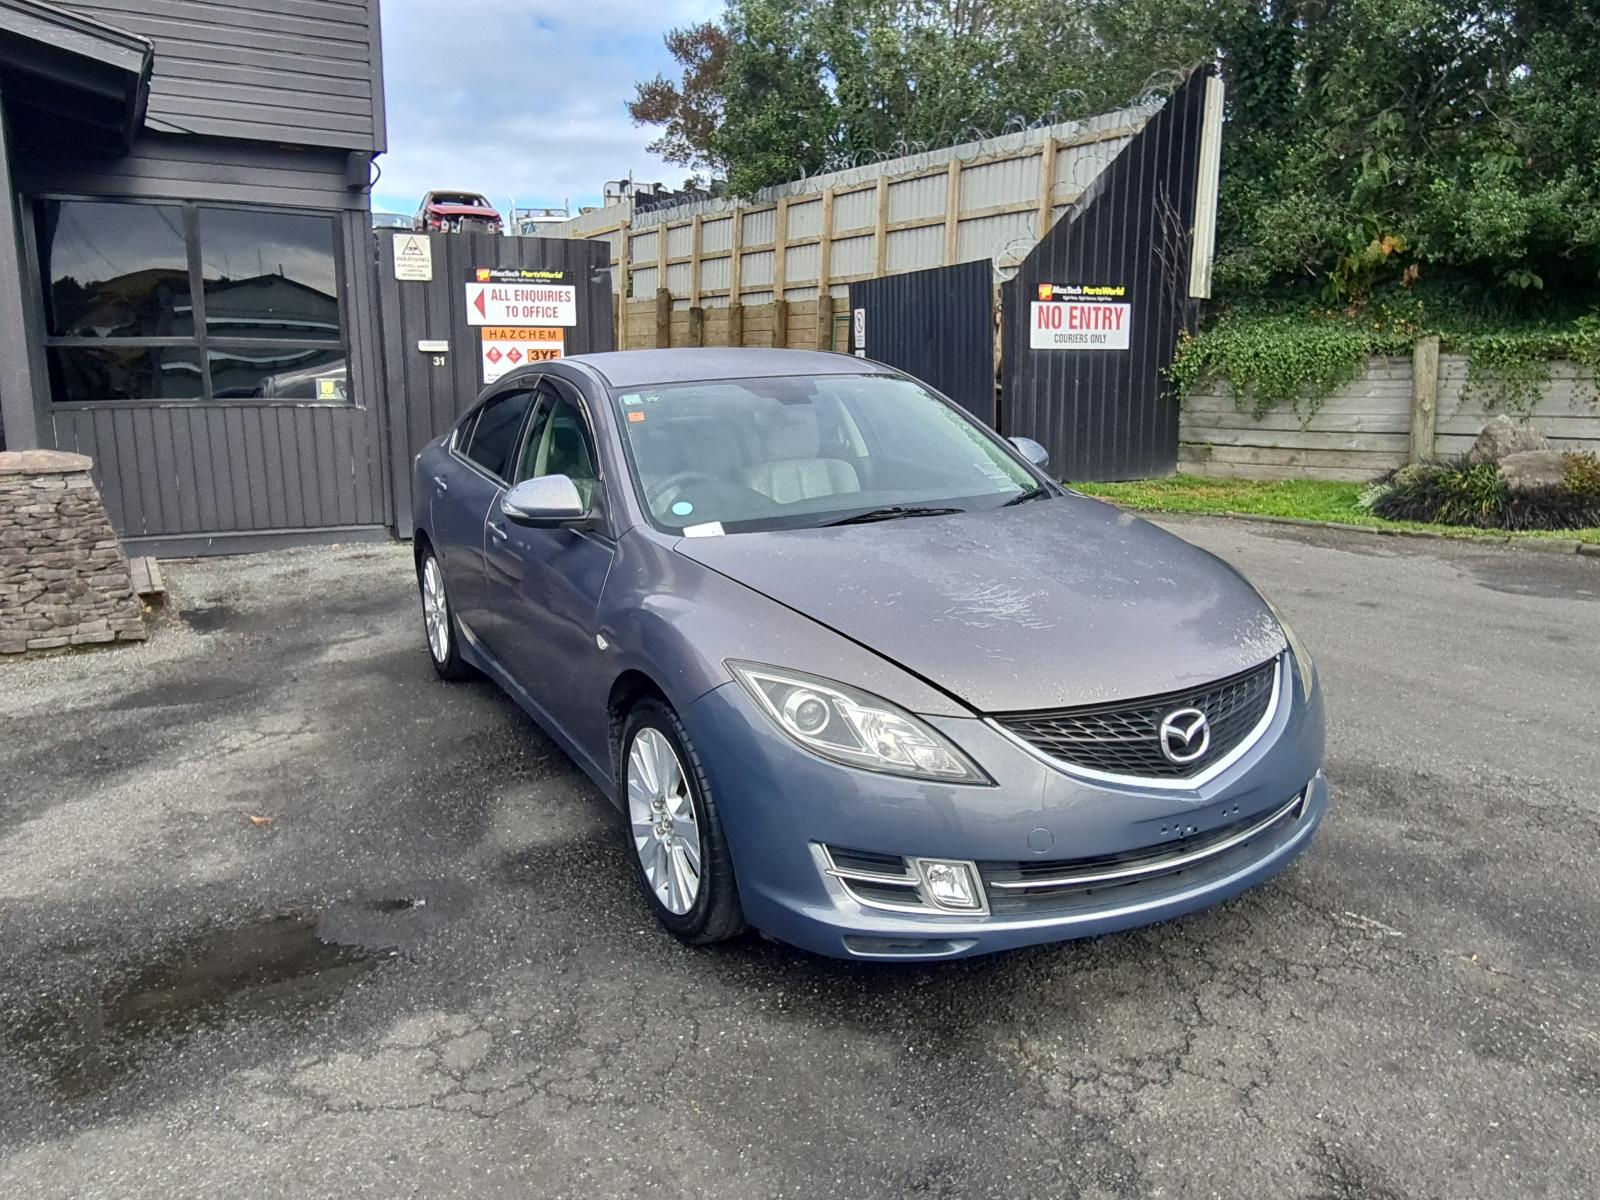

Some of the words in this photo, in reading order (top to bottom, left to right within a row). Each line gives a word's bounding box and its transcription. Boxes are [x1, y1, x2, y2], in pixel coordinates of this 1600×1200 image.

[520, 270, 563, 279] PartsWorld
[491, 288, 511, 301] ALL
[514, 289, 571, 303] ENQUIRIES
[1082, 286, 1125, 296] PartsWorld
[505, 305, 519, 318] TO
[522, 306, 559, 318] OFFICE
[1037, 305, 1062, 330] NO
[1069, 306, 1124, 331] ENTRY
[489, 329, 557, 340] HAZCHEM
[1054, 333, 1088, 344] COURIERS
[1090, 334, 1107, 344] ONLY
[432, 356, 445, 367] 31
